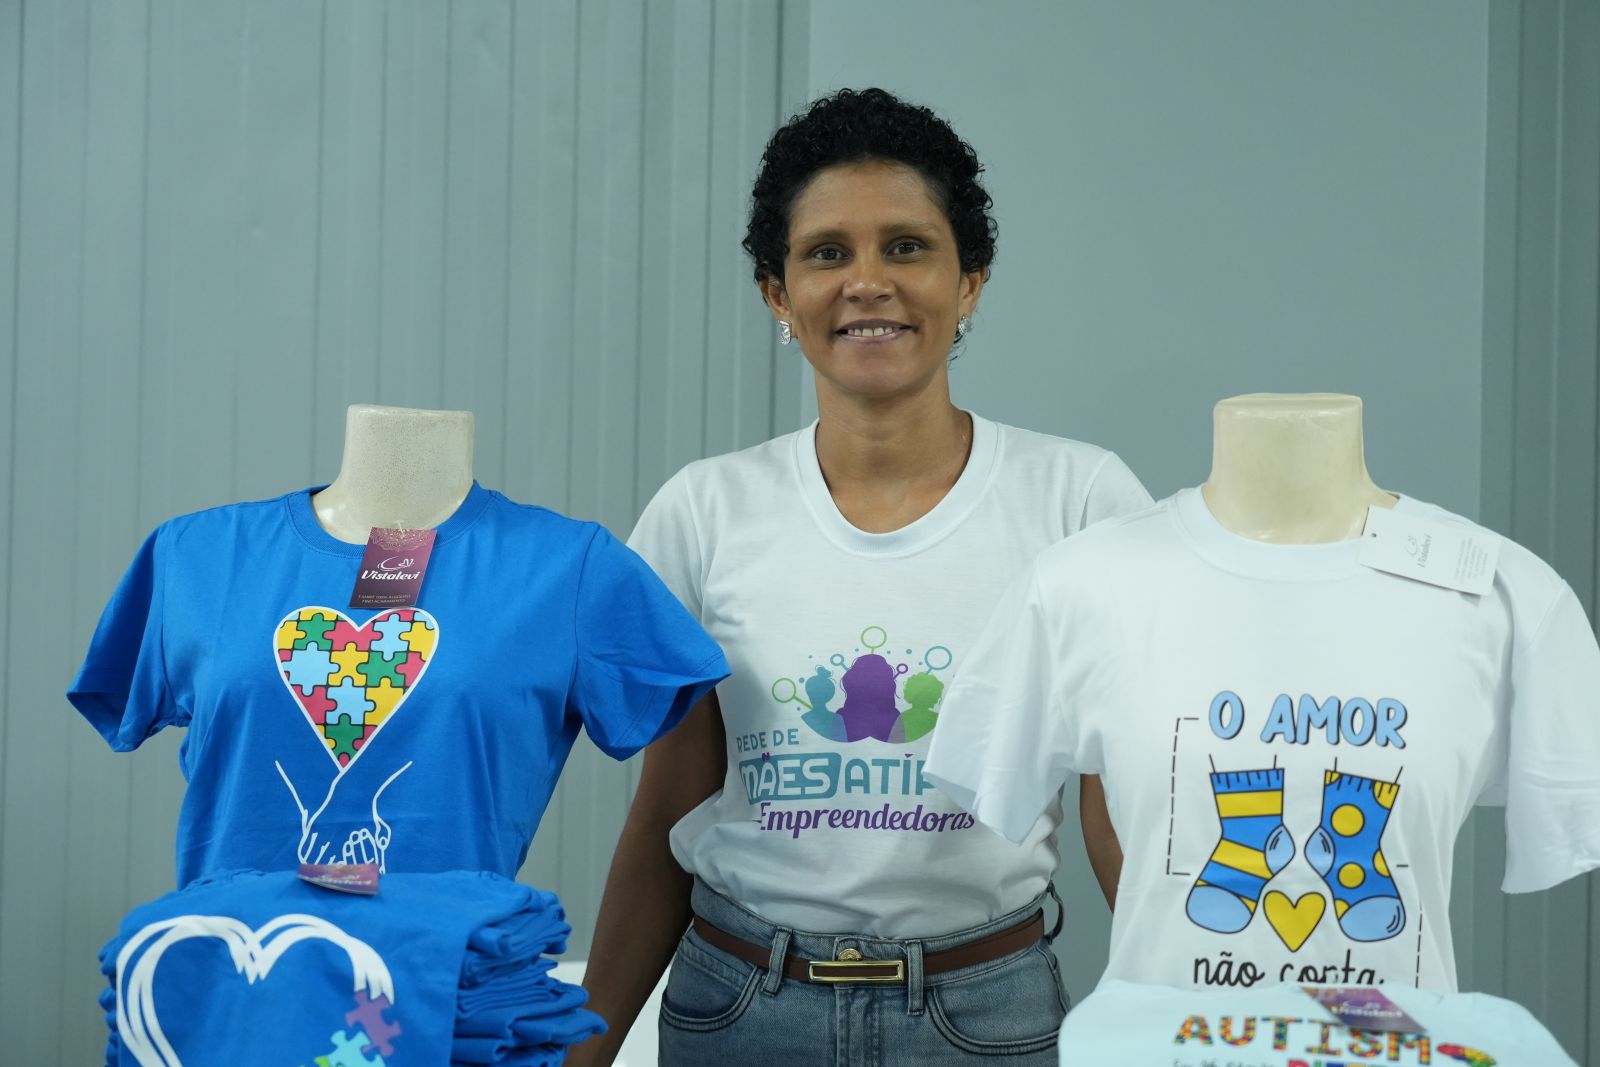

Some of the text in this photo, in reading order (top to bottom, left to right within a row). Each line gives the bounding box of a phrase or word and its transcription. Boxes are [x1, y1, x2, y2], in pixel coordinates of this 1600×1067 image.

[361, 570, 420, 580] Vistalevi
[1208, 690, 1408, 749] O AMOR
[736, 728, 800, 753] REDE DE
[752, 802, 975, 839] Empreendedoras
[1193, 952, 1265, 988] não
